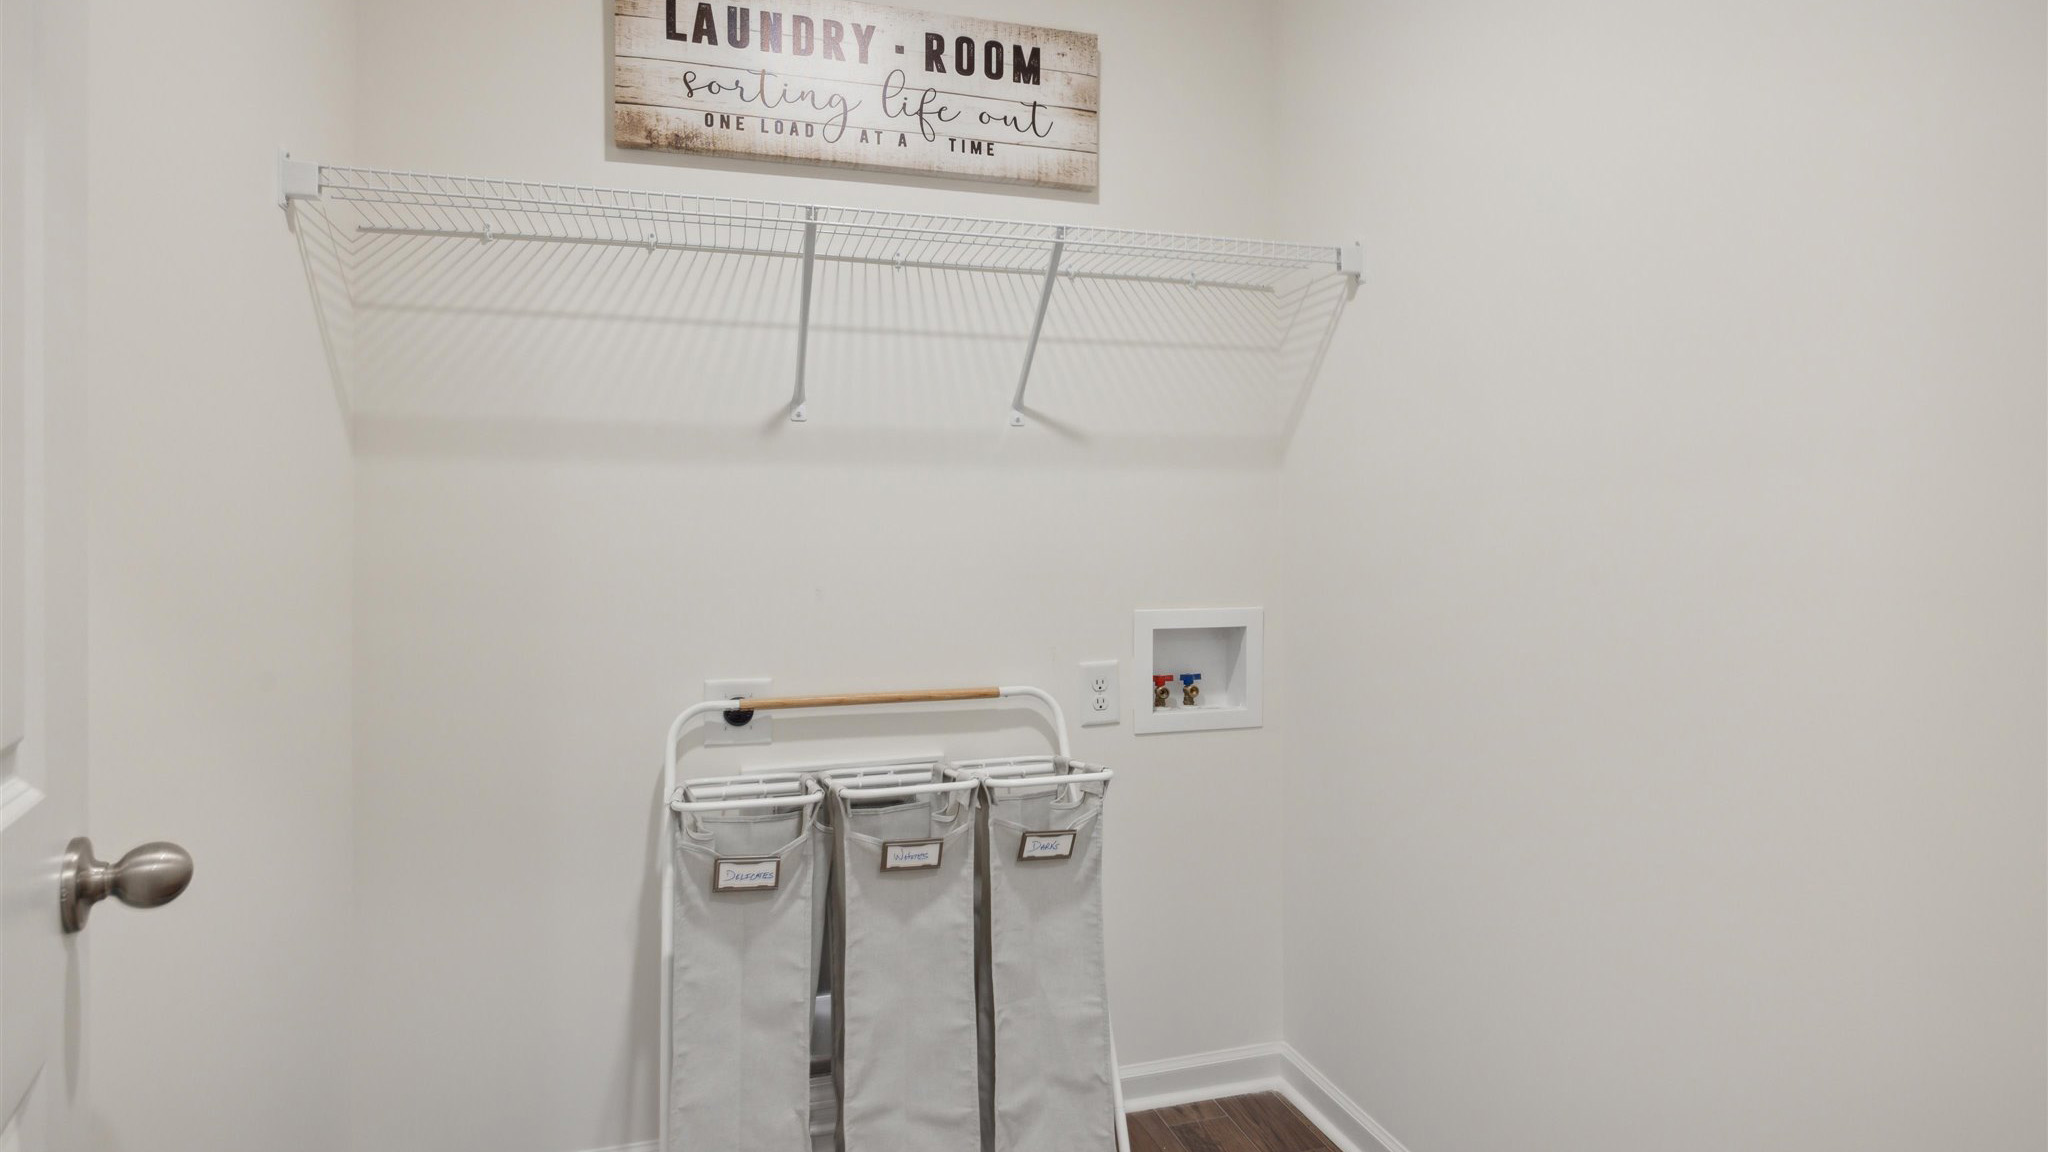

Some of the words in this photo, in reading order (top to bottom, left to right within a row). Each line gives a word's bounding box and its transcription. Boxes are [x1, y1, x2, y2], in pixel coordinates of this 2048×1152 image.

[665, 0, 876, 65] LAUNDRY
[924, 32, 1041, 86] ROOM
[682, 68, 863, 144] sorting
[882, 69, 961, 142] life
[979, 100, 1054, 138] out
[704, 112, 745, 131] ONE
[760, 118, 815, 138] LOAD
[859, 129, 883, 145] AT
[897, 133, 907, 147] A
[948, 137, 995, 157] TIME
